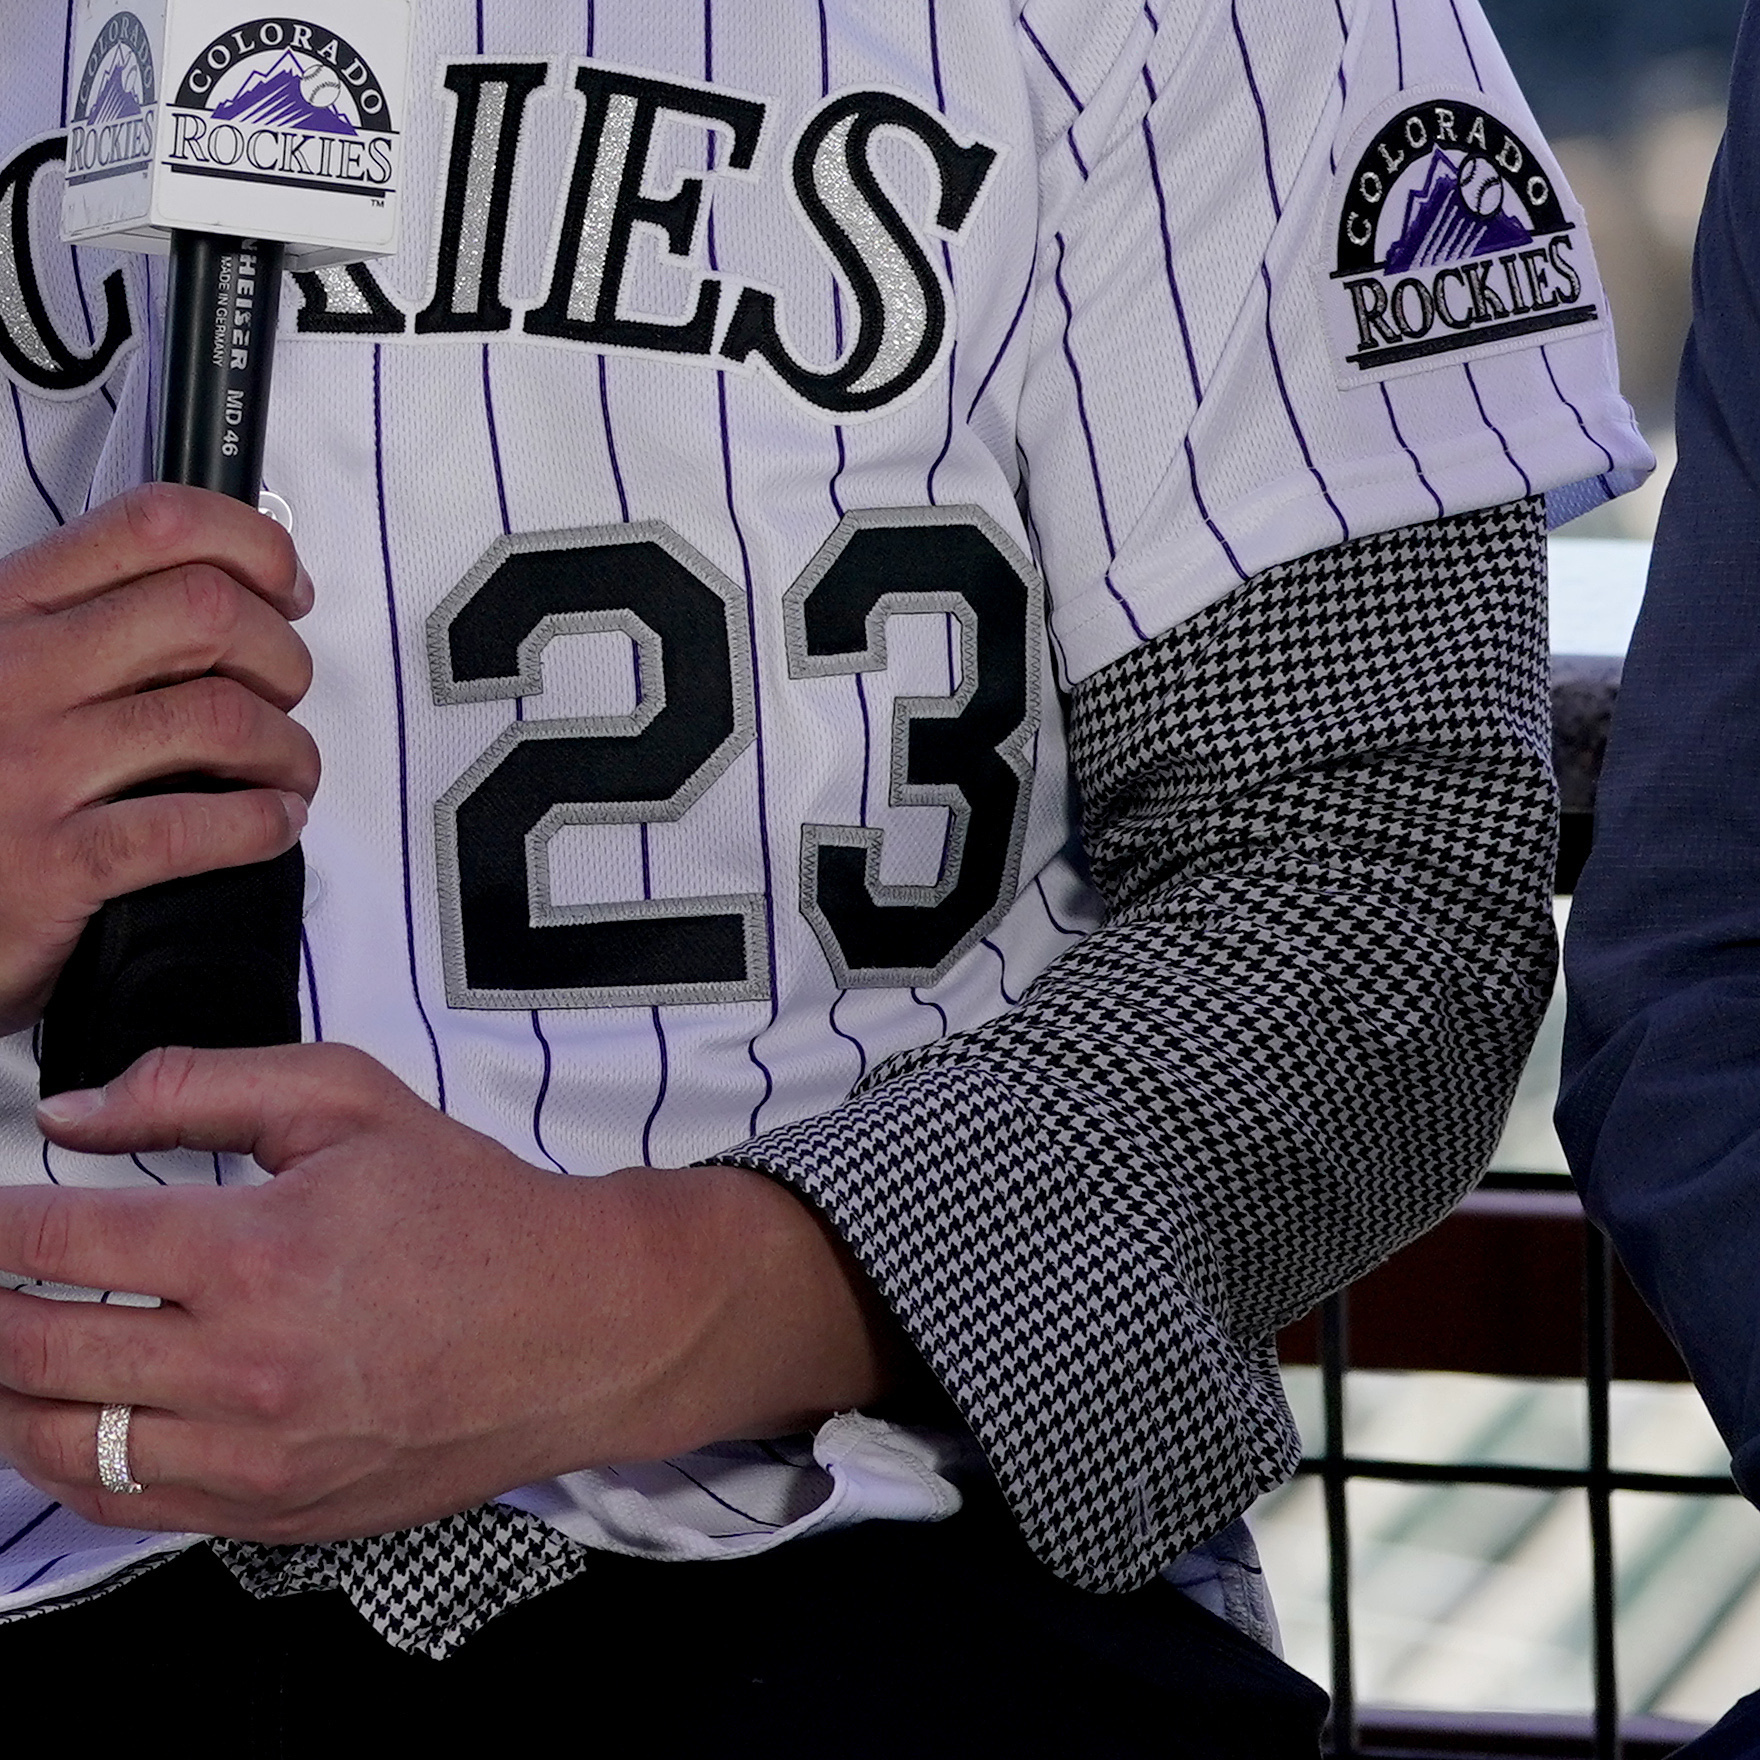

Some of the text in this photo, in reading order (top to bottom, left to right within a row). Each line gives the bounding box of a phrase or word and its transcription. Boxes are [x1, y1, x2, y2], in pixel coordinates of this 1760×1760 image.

[80, 16, 153, 105] COLORADO
[187, 21, 384, 115] COLORADO
[69, 109, 154, 173] ROCKIES
[168, 112, 392, 184] ROCKIES
[1346, 106, 1549, 247] COLORADO
[212, 255, 232, 368] MADE IN GERMANY
[1343, 235, 1581, 352] ROCKIES
[221, 429, 240, 457] 46
[225, 389, 244, 426] MD
[426, 503, 1044, 1011] 23
